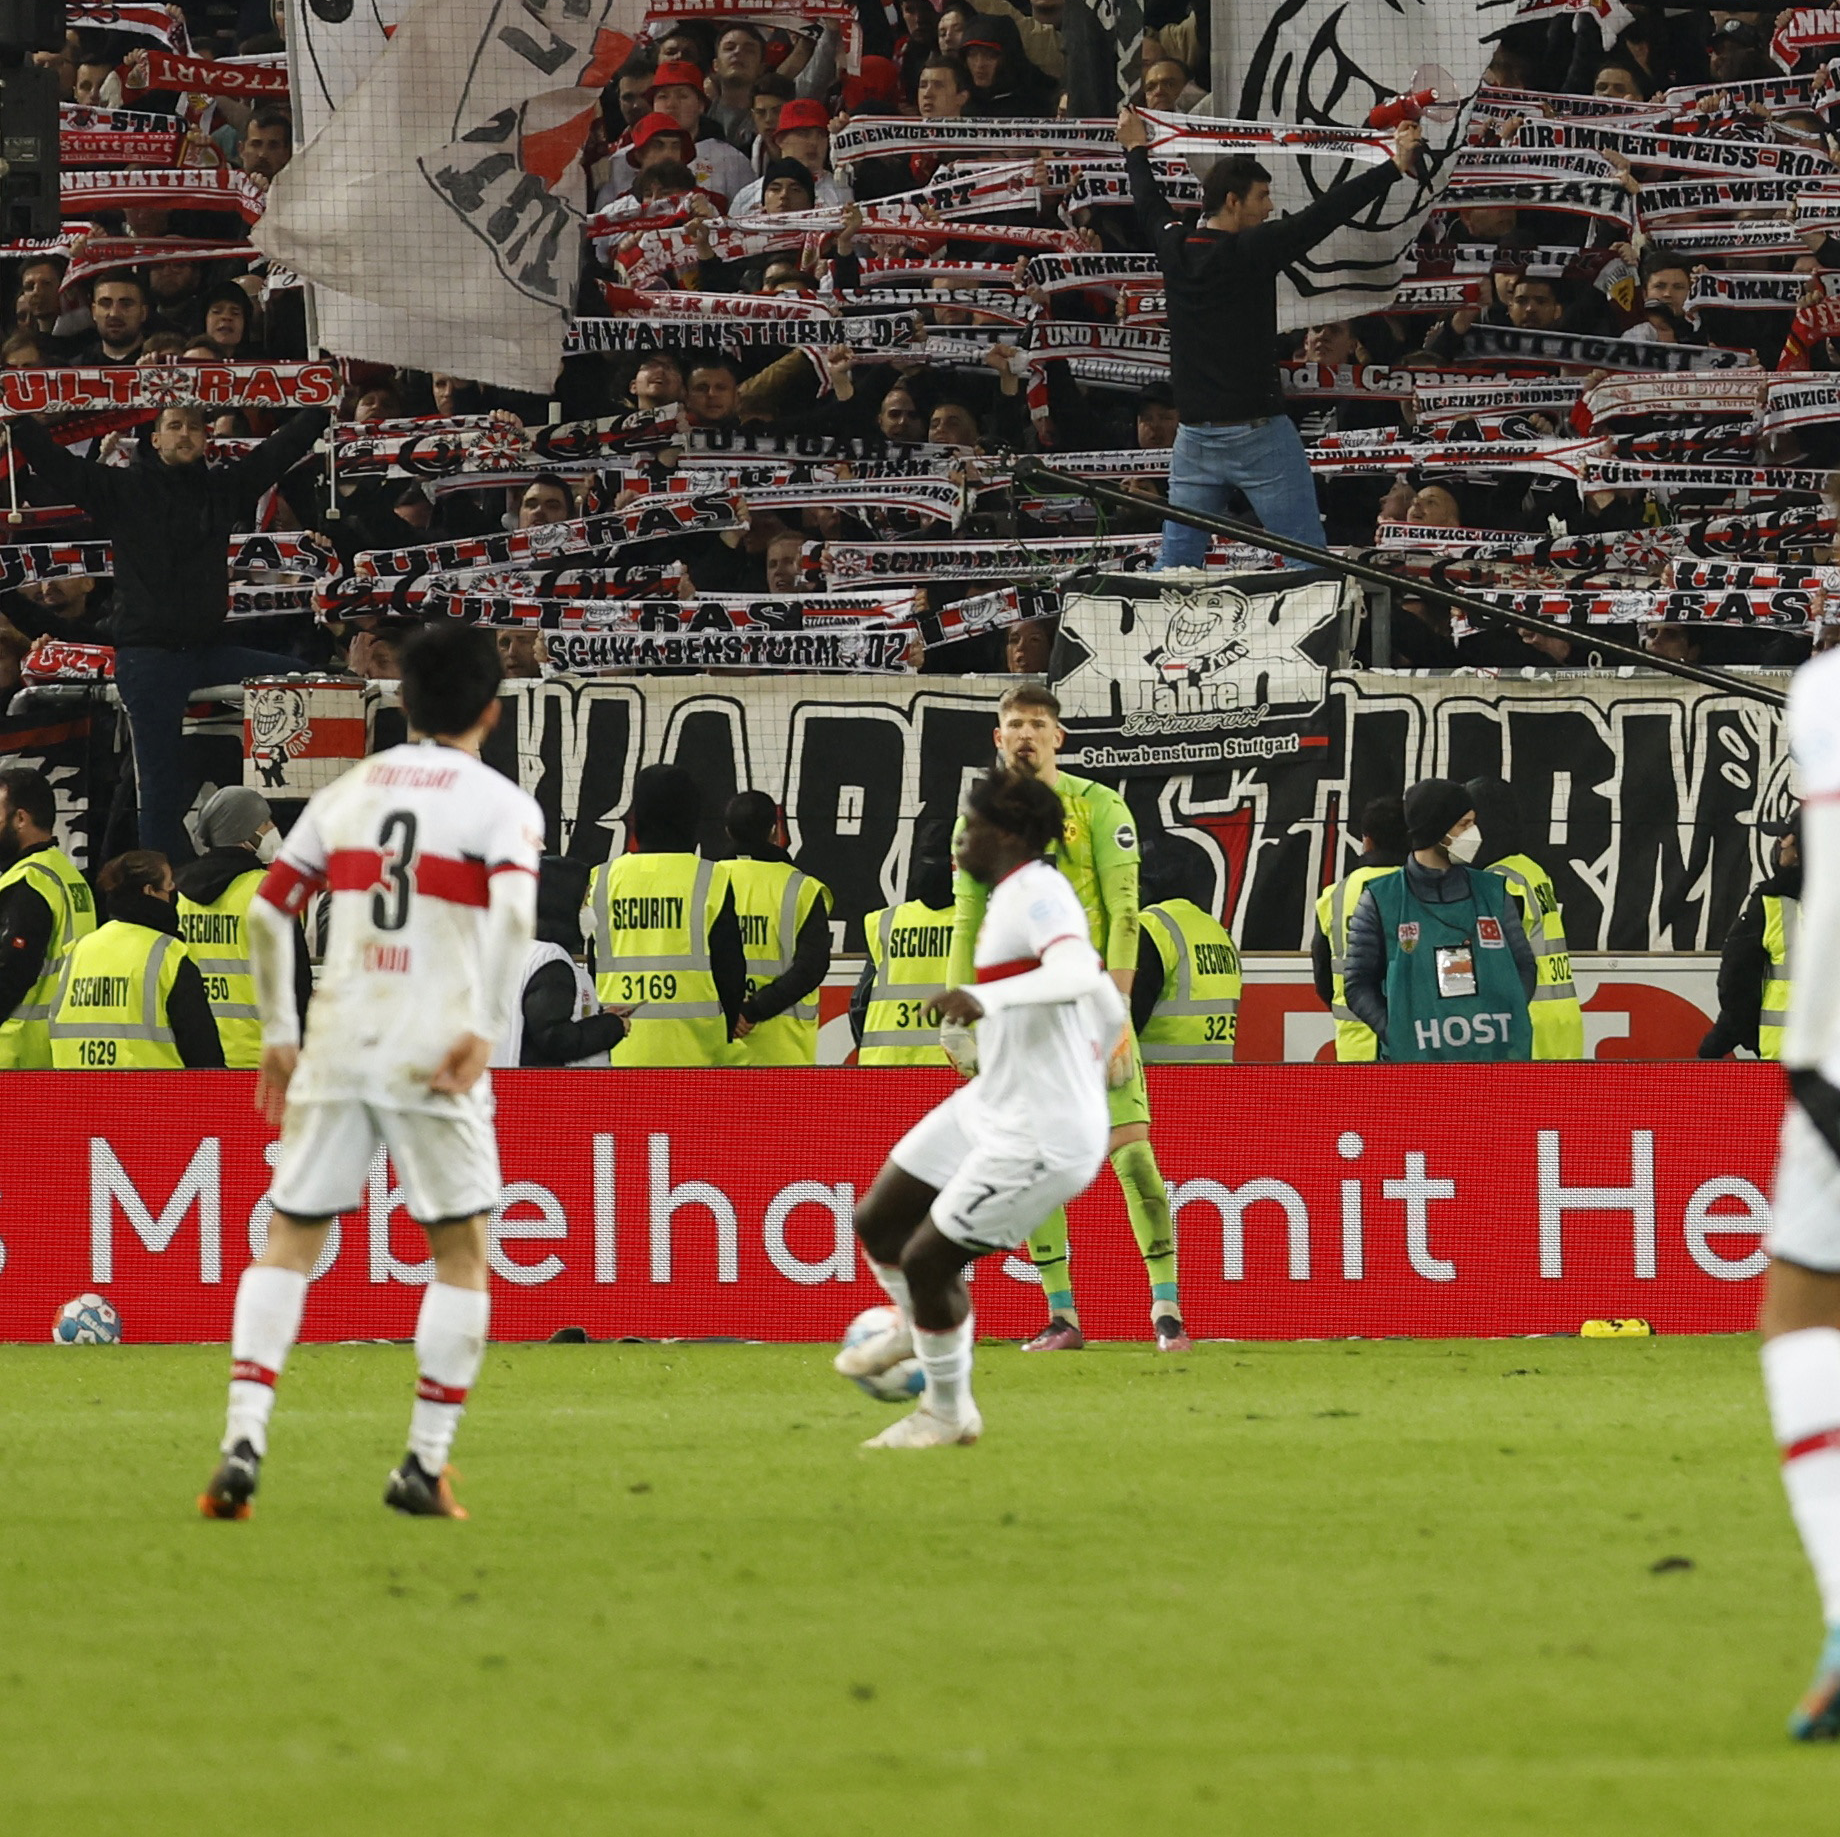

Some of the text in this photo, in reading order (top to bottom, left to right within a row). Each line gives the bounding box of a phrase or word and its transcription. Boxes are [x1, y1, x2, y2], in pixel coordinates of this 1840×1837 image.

[835, 127, 861, 143] DIE
[1040, 126, 1081, 141] SIND
[1564, 124, 1657, 157] IMMER
[1668, 138, 1760, 170] WEISS
[711, 297, 815, 320] KURVE
[1045, 323, 1086, 345] UND
[3, 366, 336, 410] ULT RAS
[1773, 388, 1837, 412] EINZIGE
[1650, 466, 1759, 489] IMMER
[548, 632, 909, 672] SCHWABENSTURM 02
[1081, 733, 1301, 767] Schwabensturm Stuttgart
[371, 809, 418, 933] 3
[181, 913, 239, 947] SECURITY
[611, 896, 684, 931] SECURITY
[69, 974, 130, 1010] SECURITY
[621, 974, 677, 1000] 3169
[1414, 1012, 1514, 1051] HOST
[78, 1040, 116, 1067] 1629
[967, 1181, 1000, 1215] 7
[1165, 1129, 1458, 1284] mit
